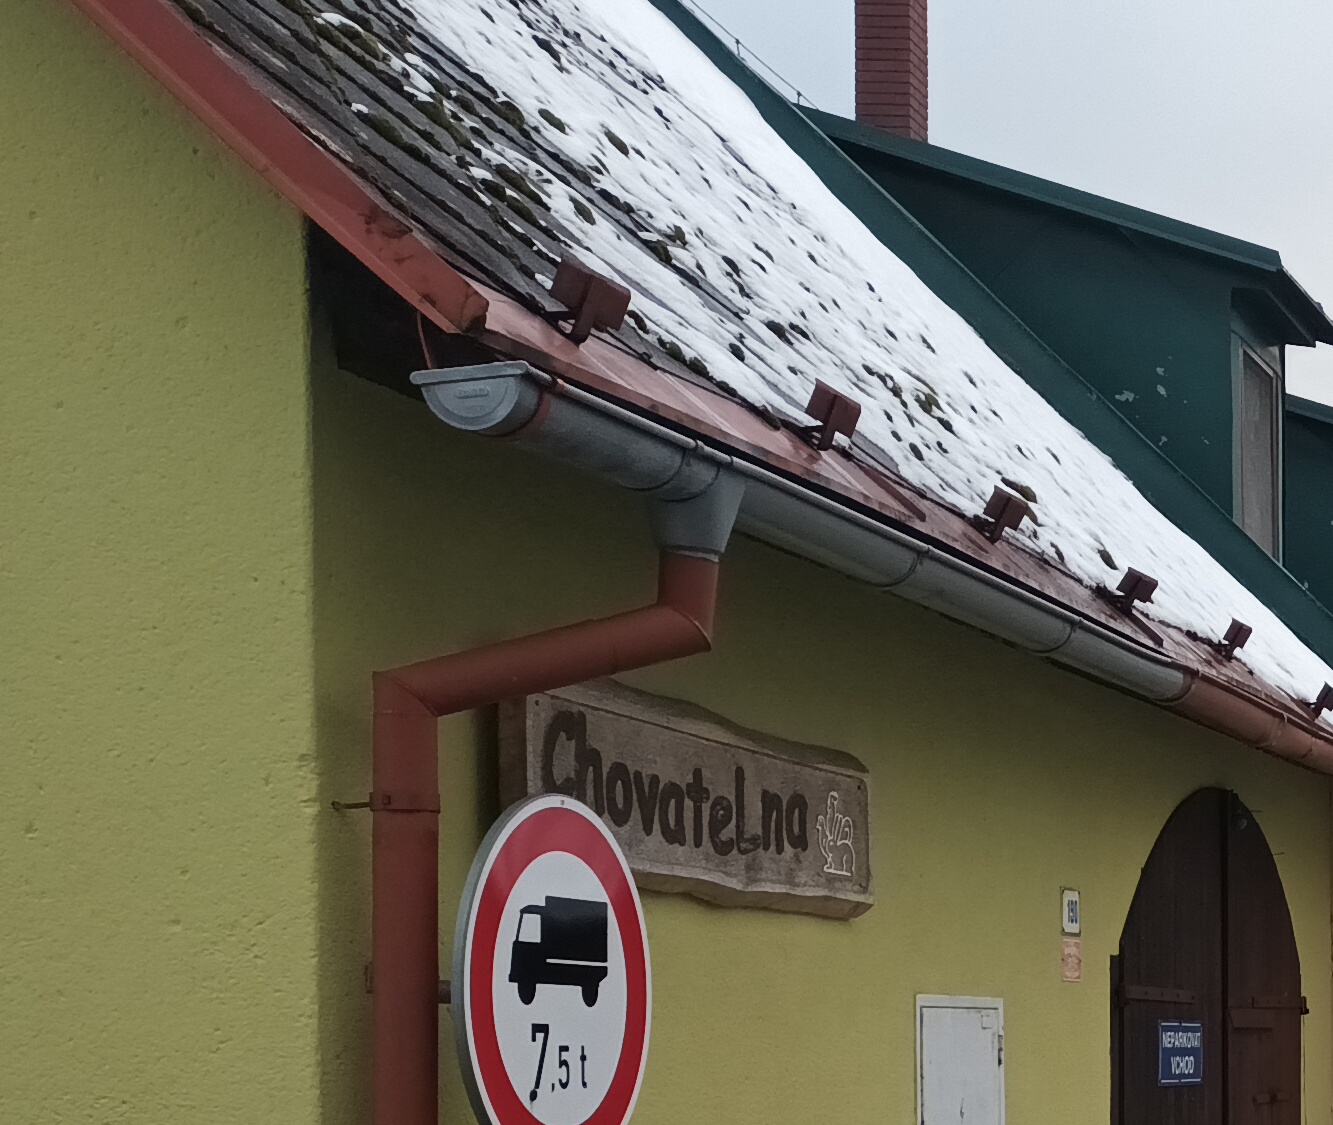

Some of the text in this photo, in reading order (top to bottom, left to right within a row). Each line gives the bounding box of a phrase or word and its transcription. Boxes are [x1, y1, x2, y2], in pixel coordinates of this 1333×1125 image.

[1162, 1031, 1201, 1048] NEPARKOVAT
[531, 1023, 588, 1102] 7,5 t
[1170, 1056, 1195, 1075] VCHOD
